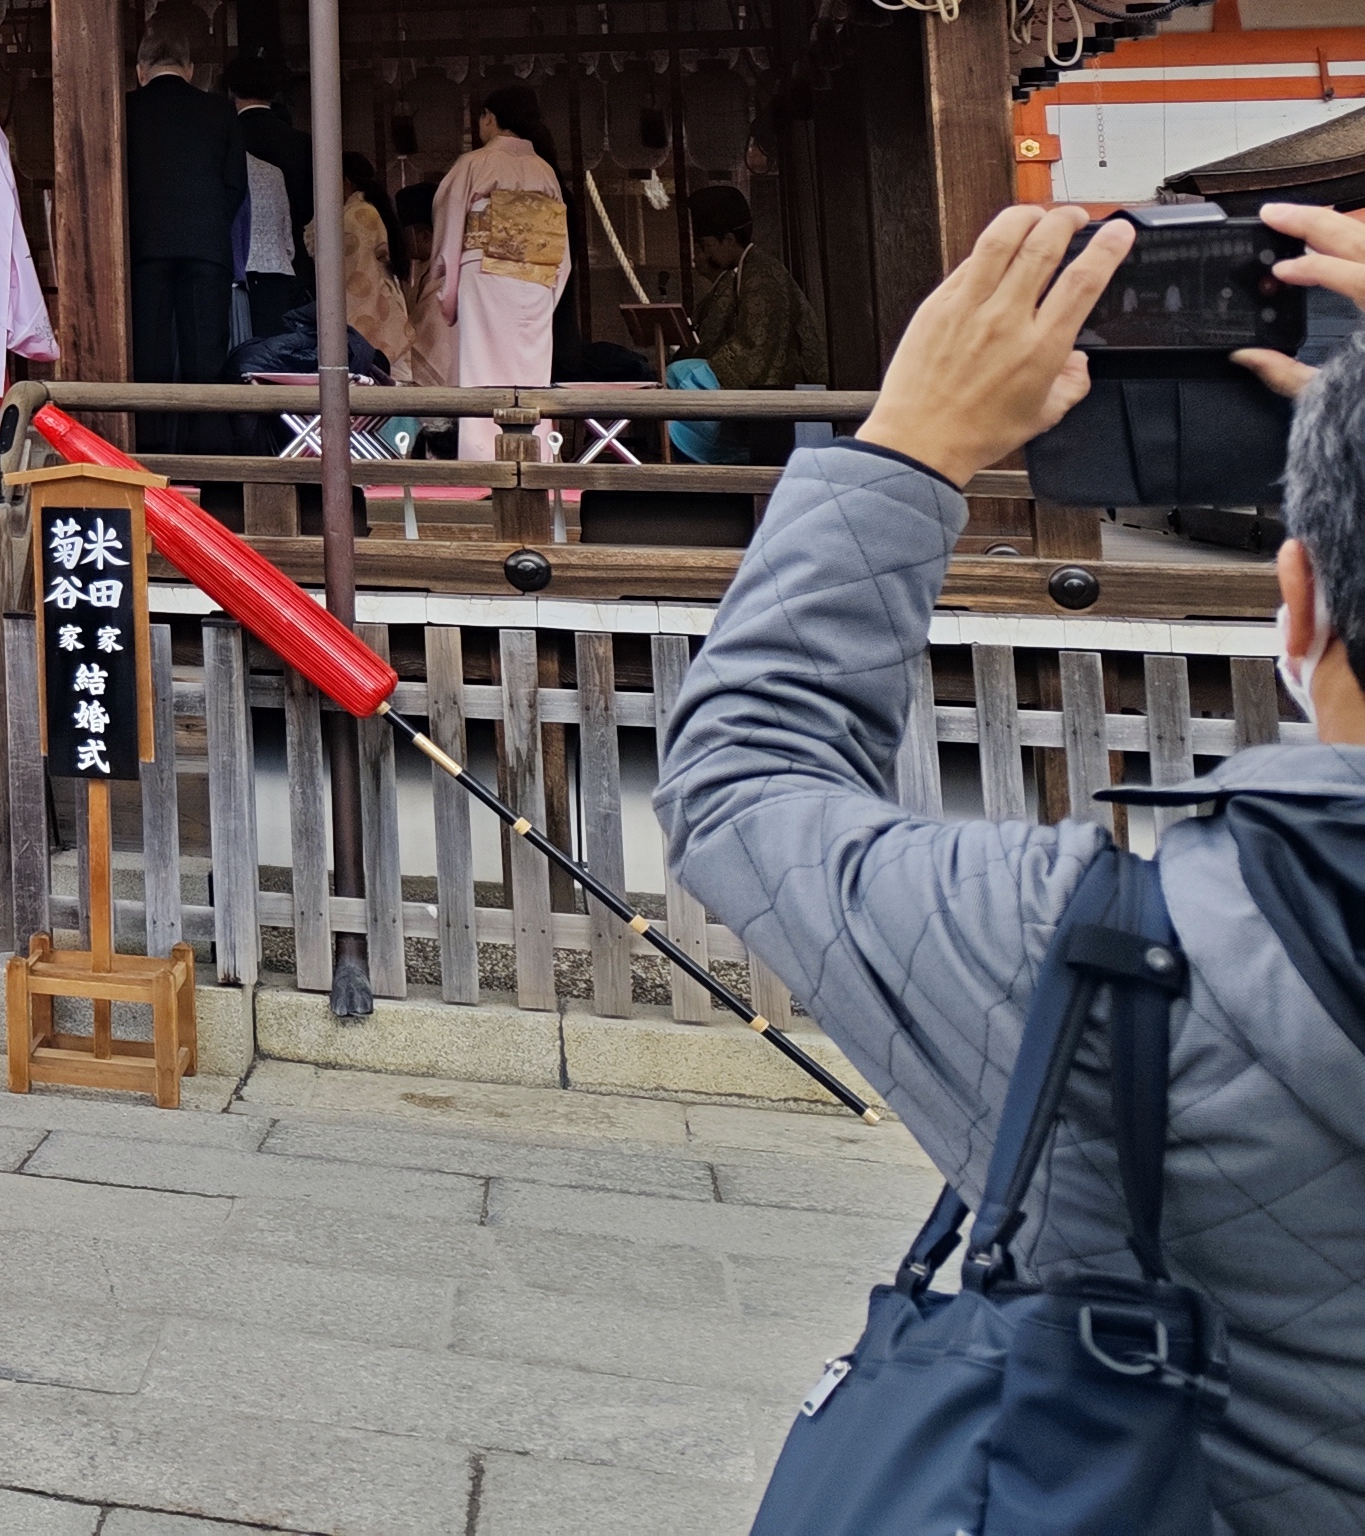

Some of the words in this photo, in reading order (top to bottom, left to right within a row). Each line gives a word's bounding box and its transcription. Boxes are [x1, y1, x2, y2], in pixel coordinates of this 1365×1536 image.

[44, 518, 90, 652] 菊谷家
[81, 518, 131, 654] 米田家
[74, 663, 111, 774] 結婚式
